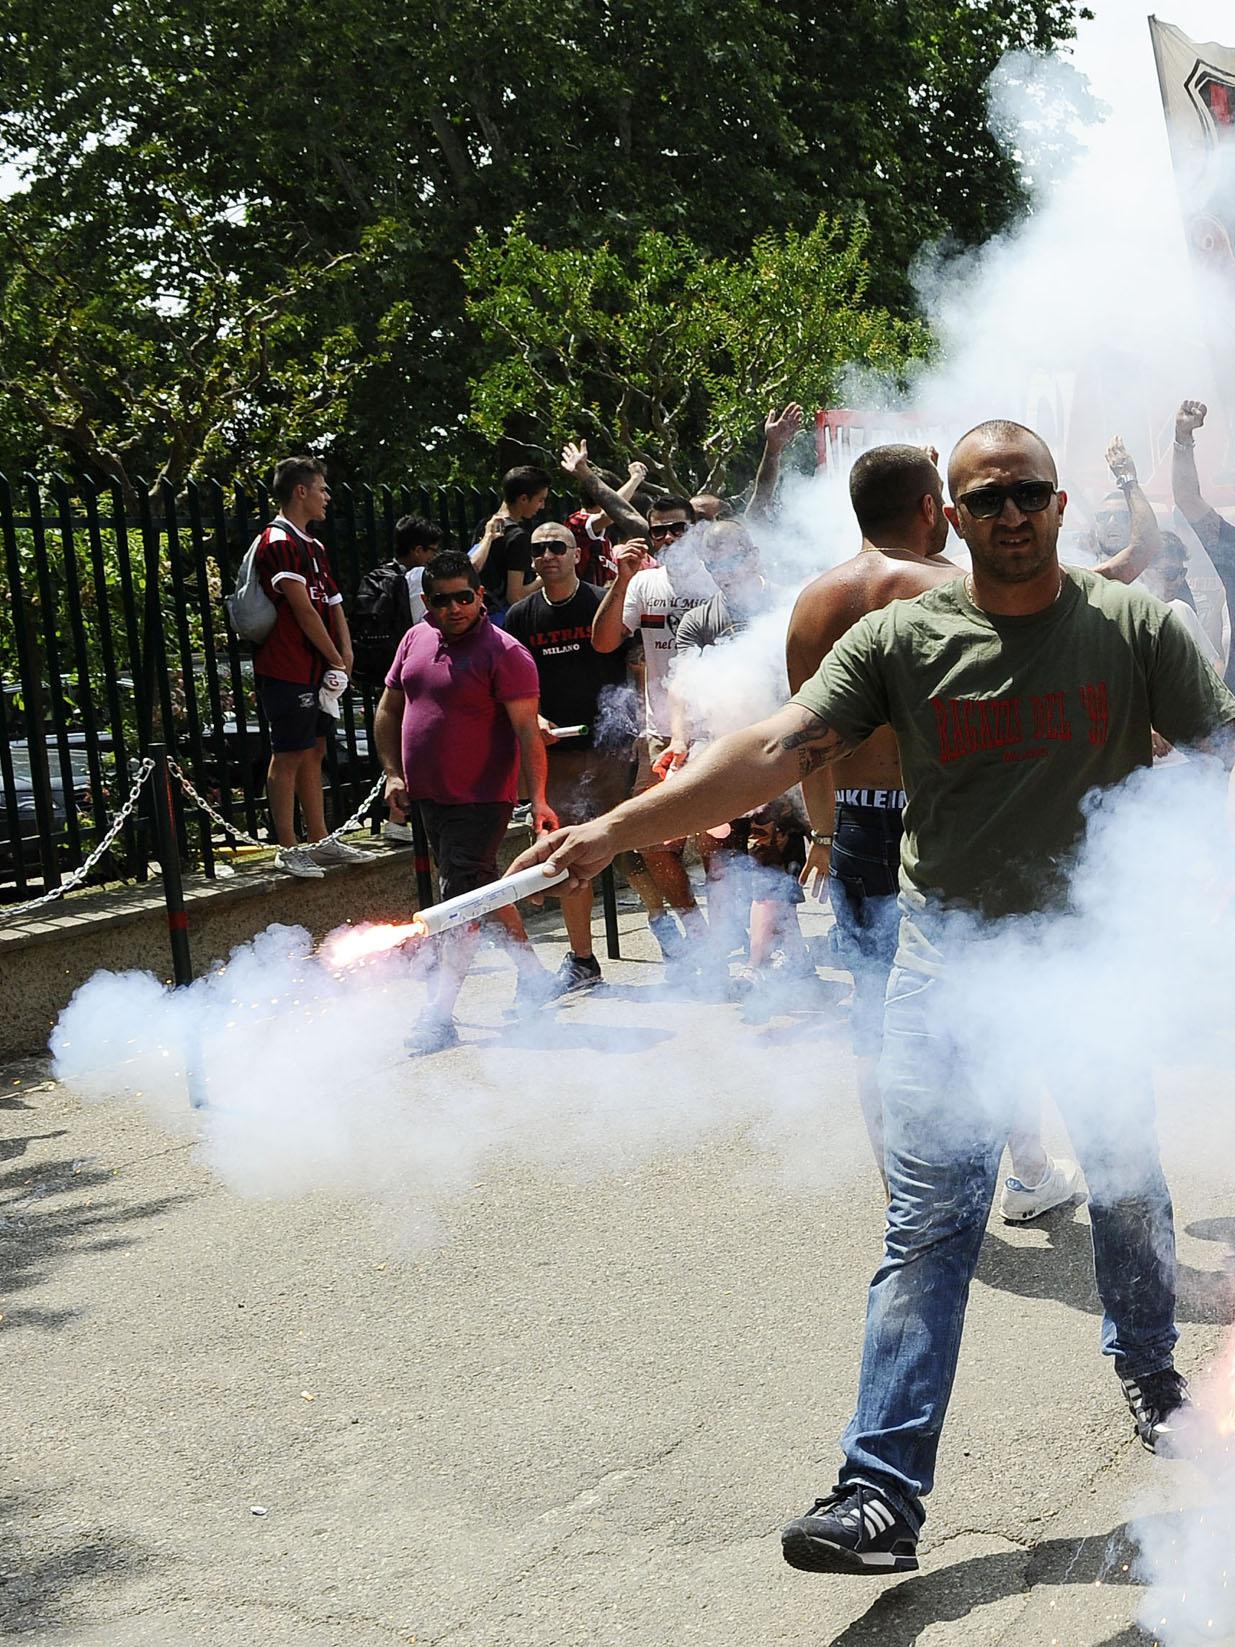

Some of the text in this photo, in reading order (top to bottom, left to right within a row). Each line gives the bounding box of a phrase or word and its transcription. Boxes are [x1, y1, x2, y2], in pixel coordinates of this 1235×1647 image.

[542, 643, 580, 656] MILANO
[929, 695, 1025, 769] RAGAZZI
[1031, 690, 1073, 742] DEL
